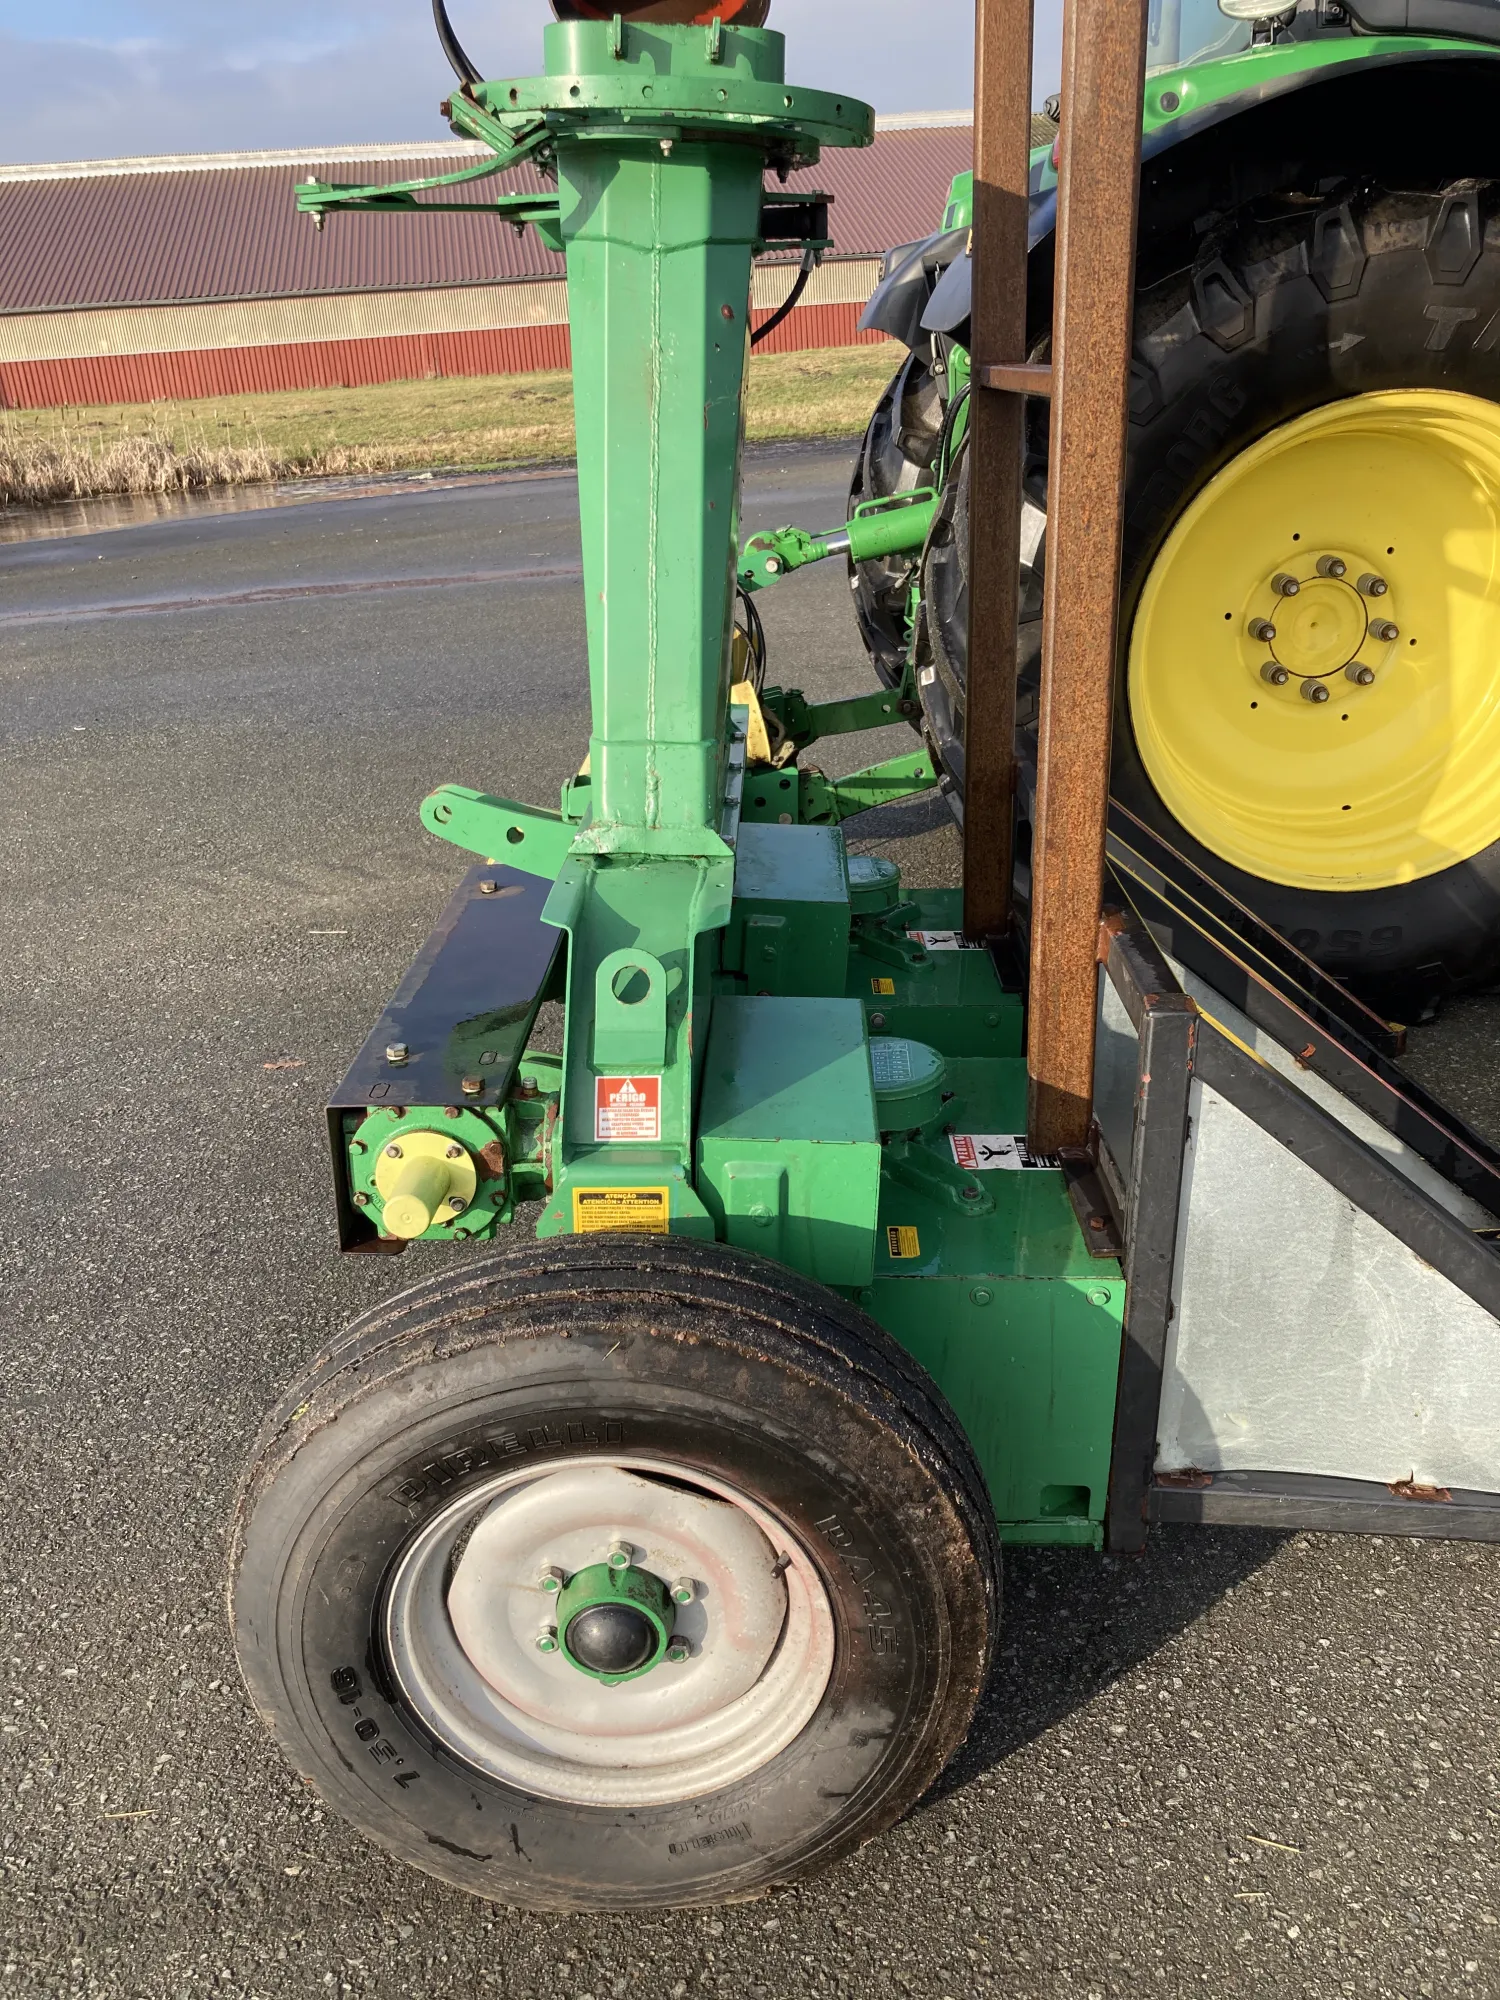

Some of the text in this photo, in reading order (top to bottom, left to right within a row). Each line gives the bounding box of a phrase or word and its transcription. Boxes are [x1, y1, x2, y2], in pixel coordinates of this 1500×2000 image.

[609, 1093, 647, 1103] PERIGO
[386, 1422, 624, 1508] PIRELLI
[330, 1666, 421, 1790] 7.50-16
